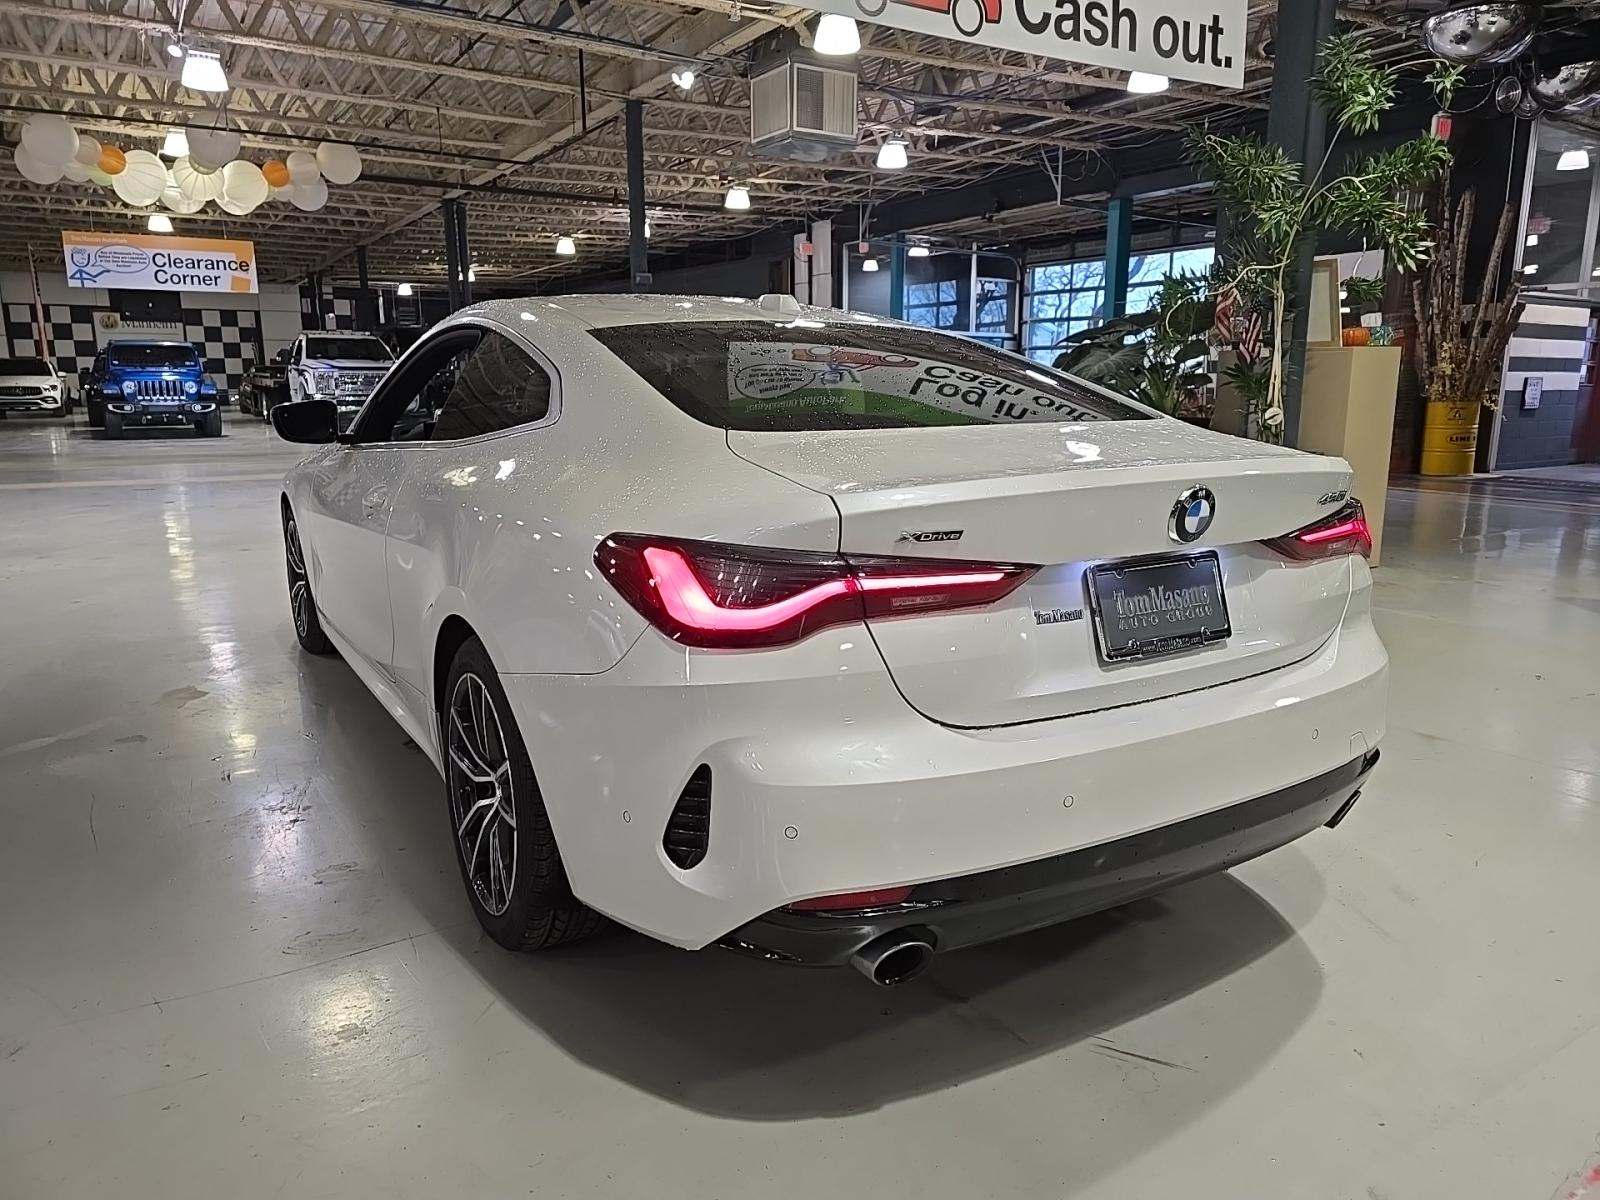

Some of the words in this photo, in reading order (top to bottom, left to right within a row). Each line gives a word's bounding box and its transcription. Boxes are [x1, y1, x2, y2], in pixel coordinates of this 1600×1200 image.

[1015, 0, 1137, 52] Cash
[1152, 14, 1233, 69] out.
[152, 252, 250, 272] Clearance
[154, 270, 221, 287] Corner
